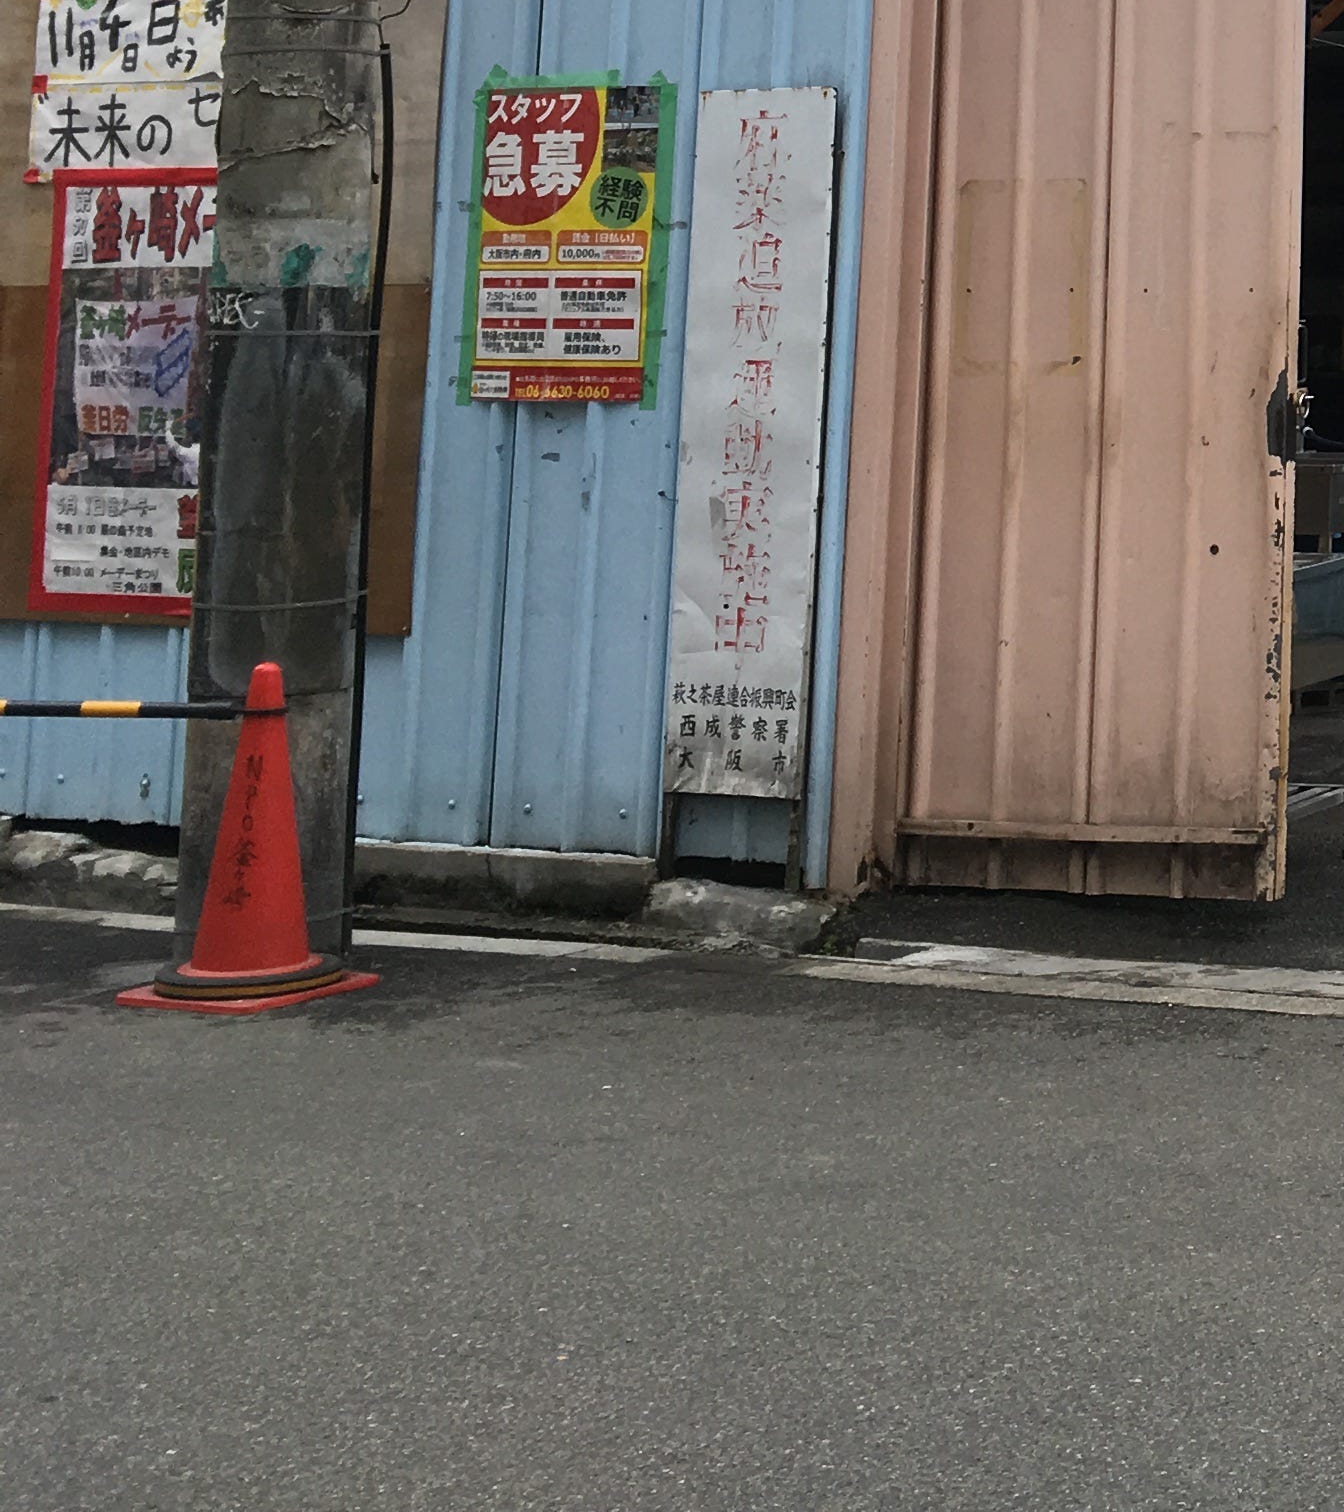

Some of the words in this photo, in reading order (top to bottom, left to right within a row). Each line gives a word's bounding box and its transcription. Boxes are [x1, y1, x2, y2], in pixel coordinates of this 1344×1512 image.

[488, 94, 583, 125] スタッフ
[483, 131, 586, 198] 急募
[679, 713, 789, 746] 西成警察署
[677, 746, 788, 776] 大阪市
